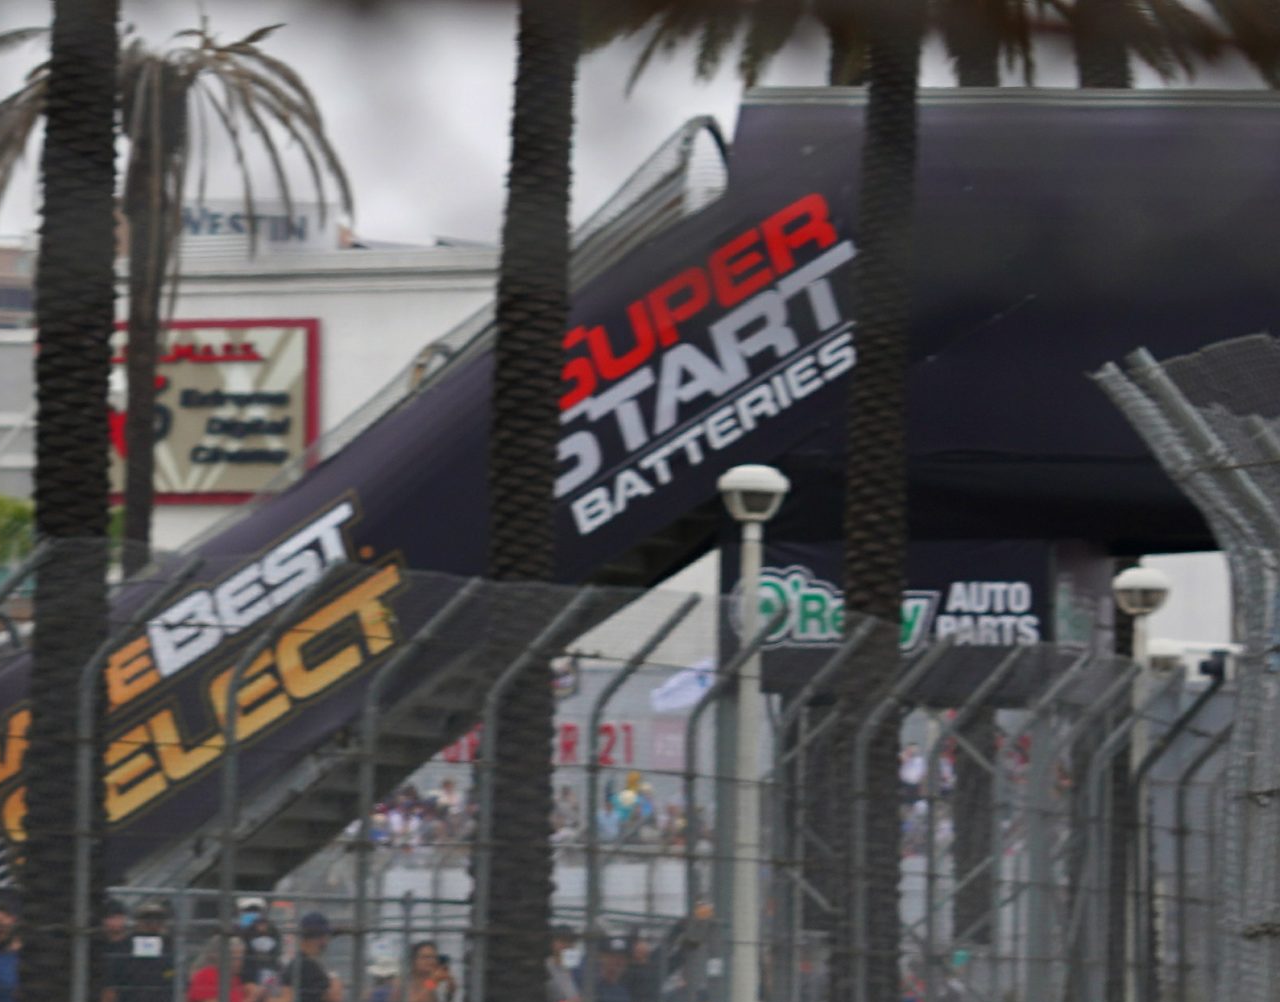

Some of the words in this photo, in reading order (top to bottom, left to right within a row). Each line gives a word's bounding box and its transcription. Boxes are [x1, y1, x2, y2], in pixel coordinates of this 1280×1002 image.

[553, 239, 858, 498] START
[560, 192, 838, 411] SUPER
[570, 331, 857, 535] BATTERIES
[936, 614, 1040, 646] PARTS
[945, 581, 1033, 614] AUTO
